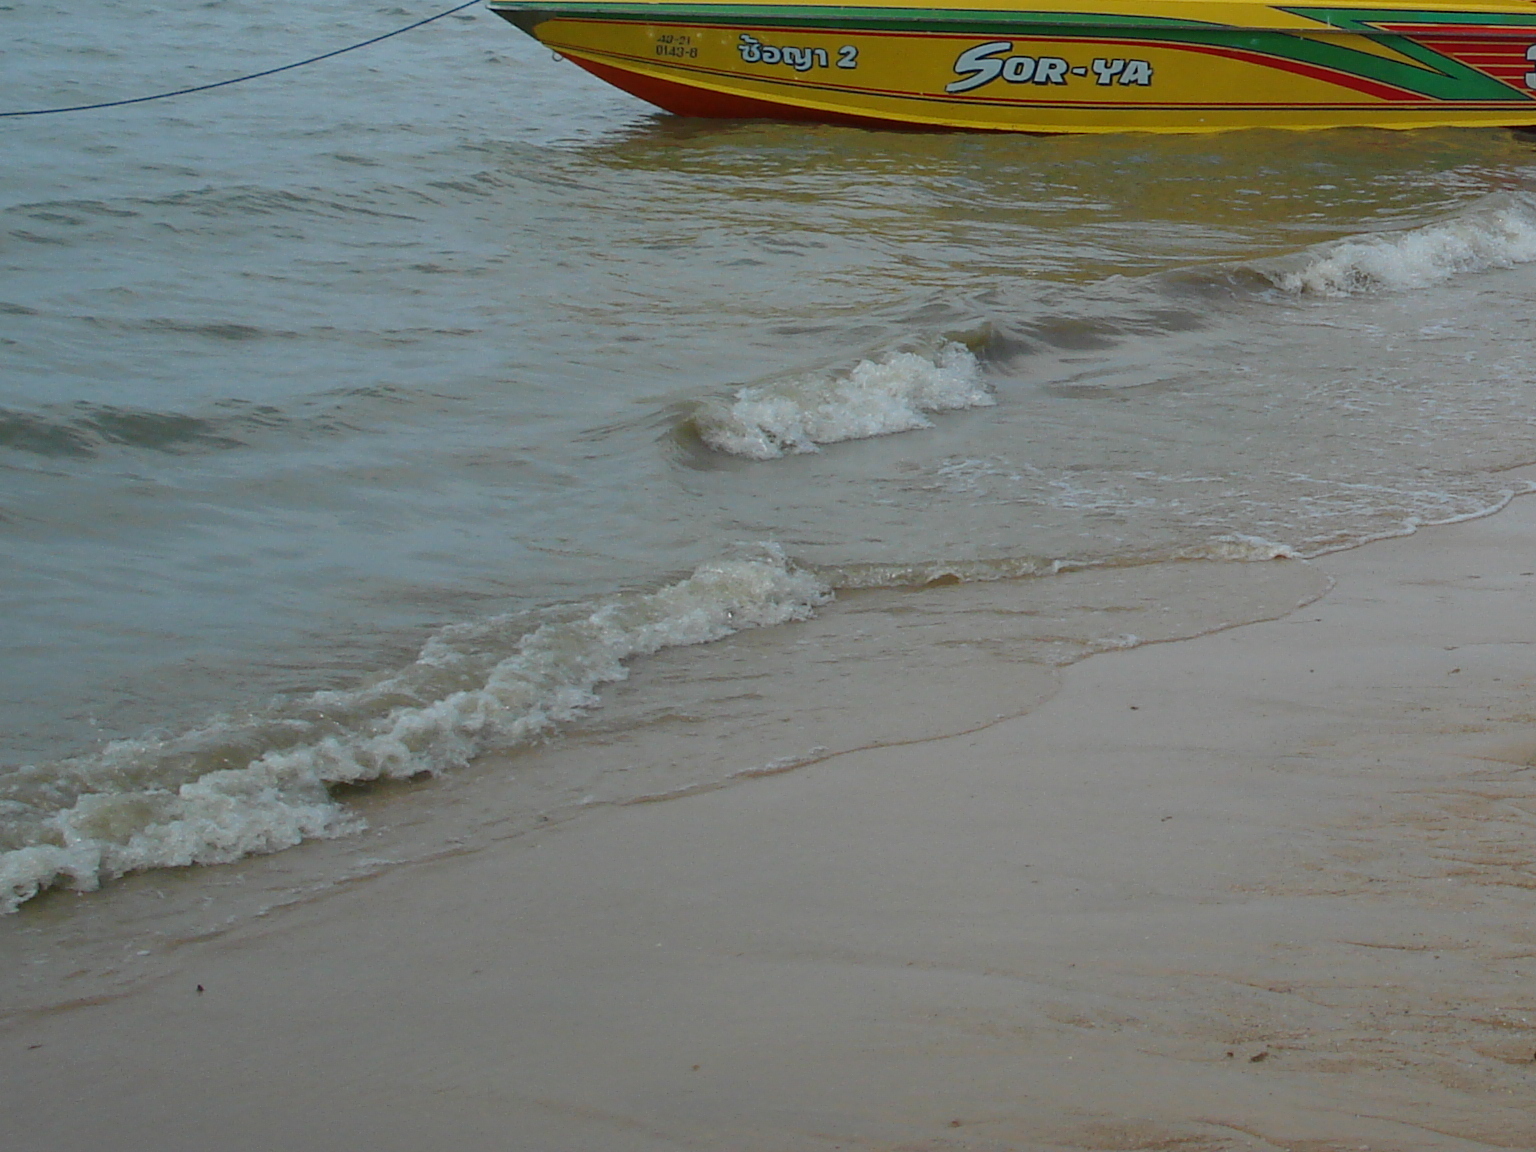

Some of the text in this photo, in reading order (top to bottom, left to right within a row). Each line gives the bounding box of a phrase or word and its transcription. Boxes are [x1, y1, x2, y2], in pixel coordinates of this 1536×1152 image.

[655, 45, 699, 59] 0143-8
[837, 45, 858, 69] 2
[944, 41, 1154, 93] SOR-YA
